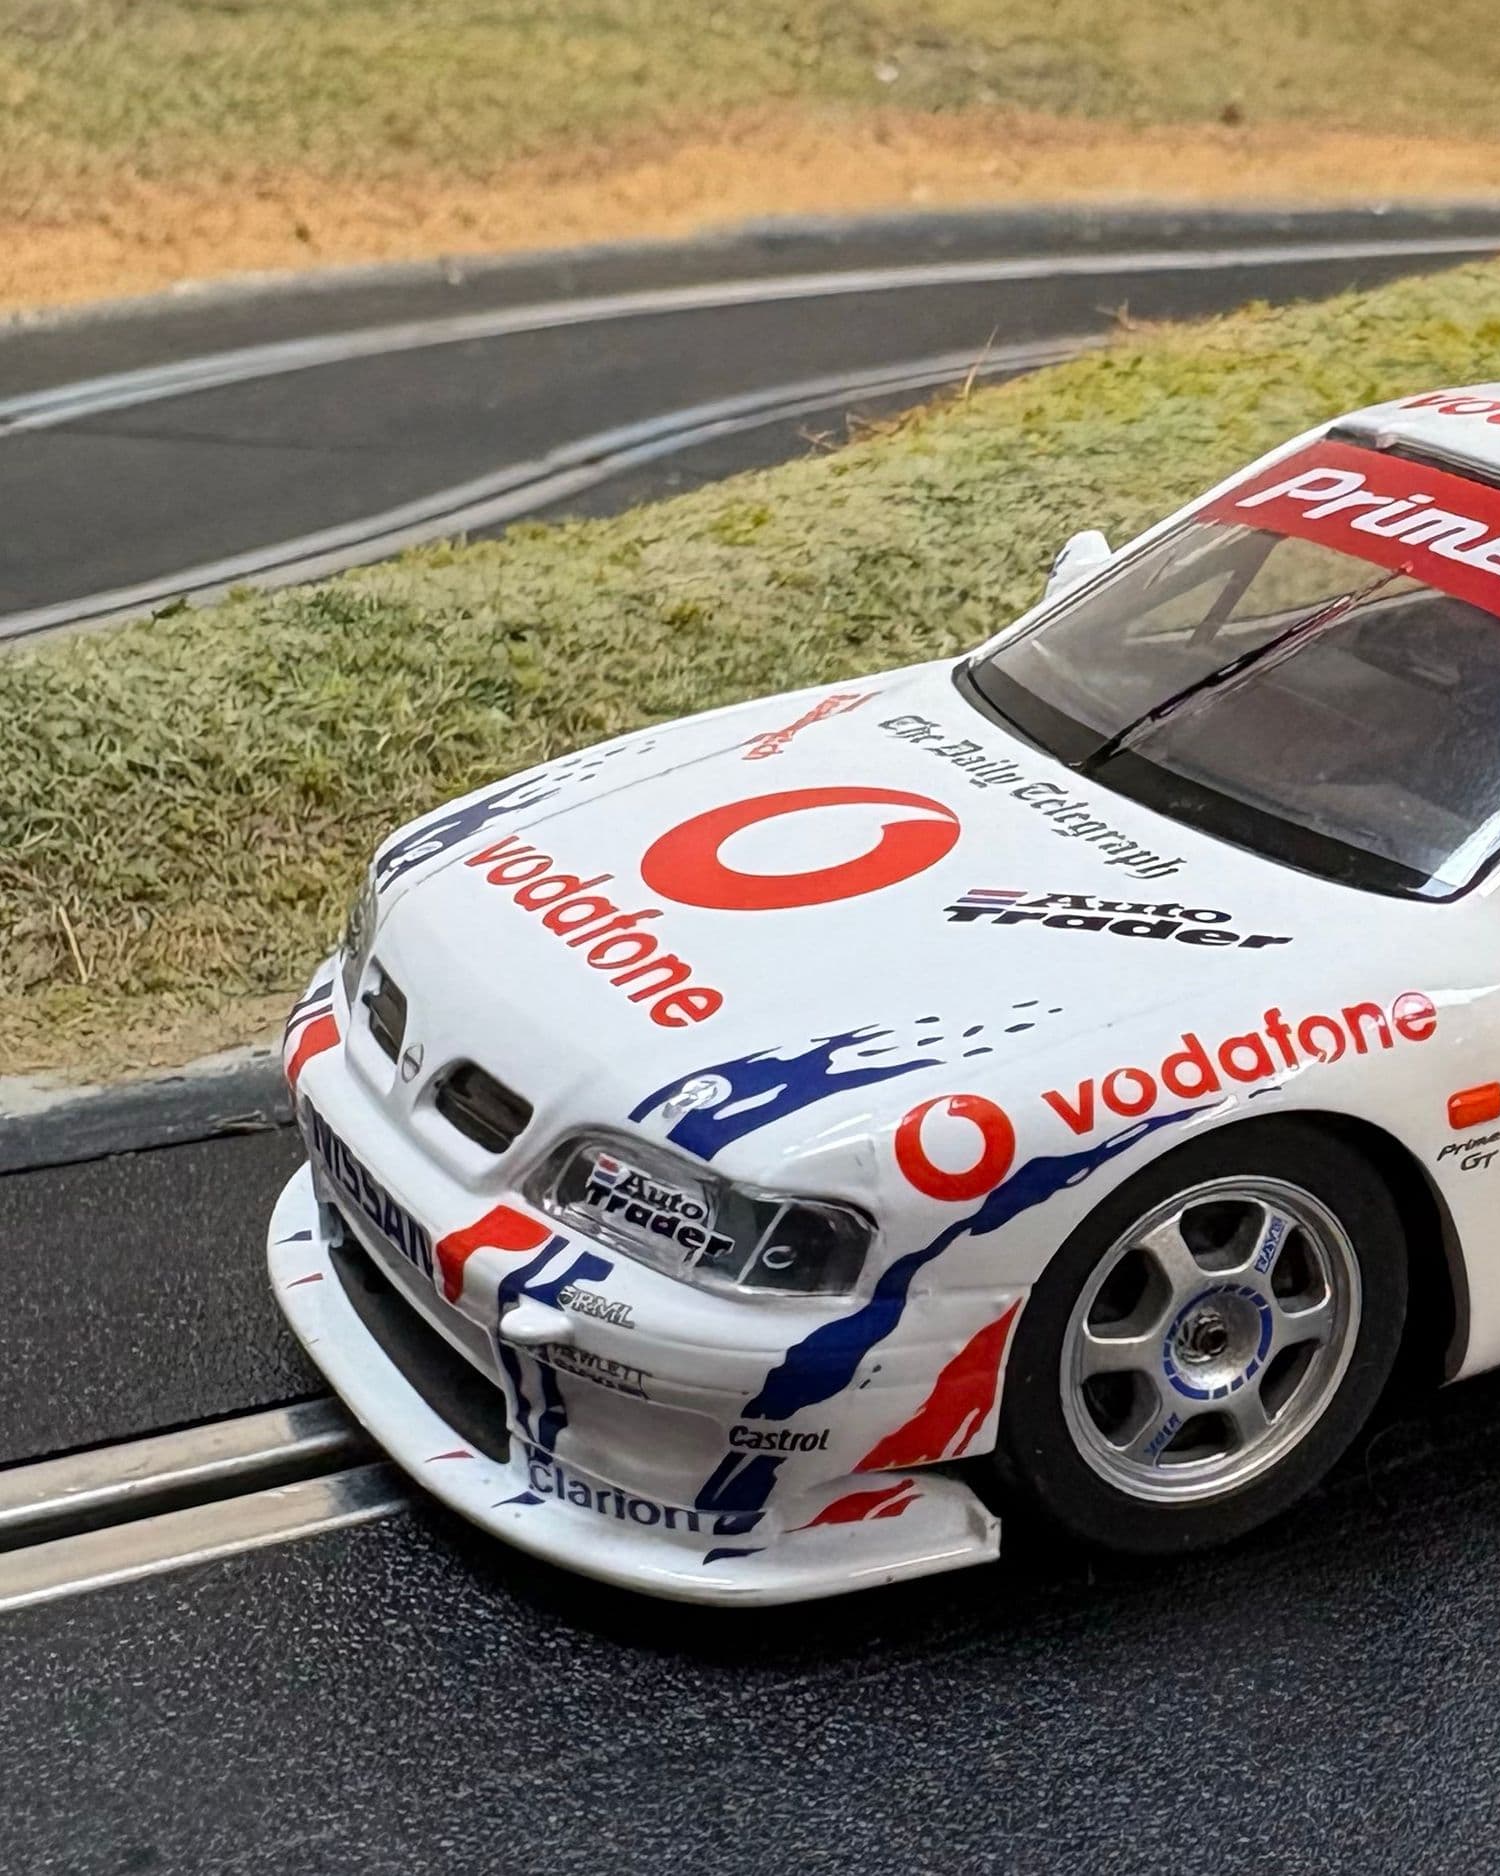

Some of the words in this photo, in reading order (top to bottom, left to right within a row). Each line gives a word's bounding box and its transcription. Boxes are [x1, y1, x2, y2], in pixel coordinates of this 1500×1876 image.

[877, 715, 945, 743] The
[924, 740, 1024, 788] Daily
[1009, 782, 1187, 879] Telegraph
[466, 835, 724, 1027] vodafone
[943, 906, 1293, 949] Trader
[1015, 893, 1232, 925] Auto
[1041, 991, 1437, 1135] vodafone
[1461, 1149, 1499, 1171] GT
[587, 1180, 734, 1257] Trader
[613, 1169, 704, 1220] Auto
[729, 1425, 829, 1451] Castrol
[529, 1460, 700, 1533] Clarion
